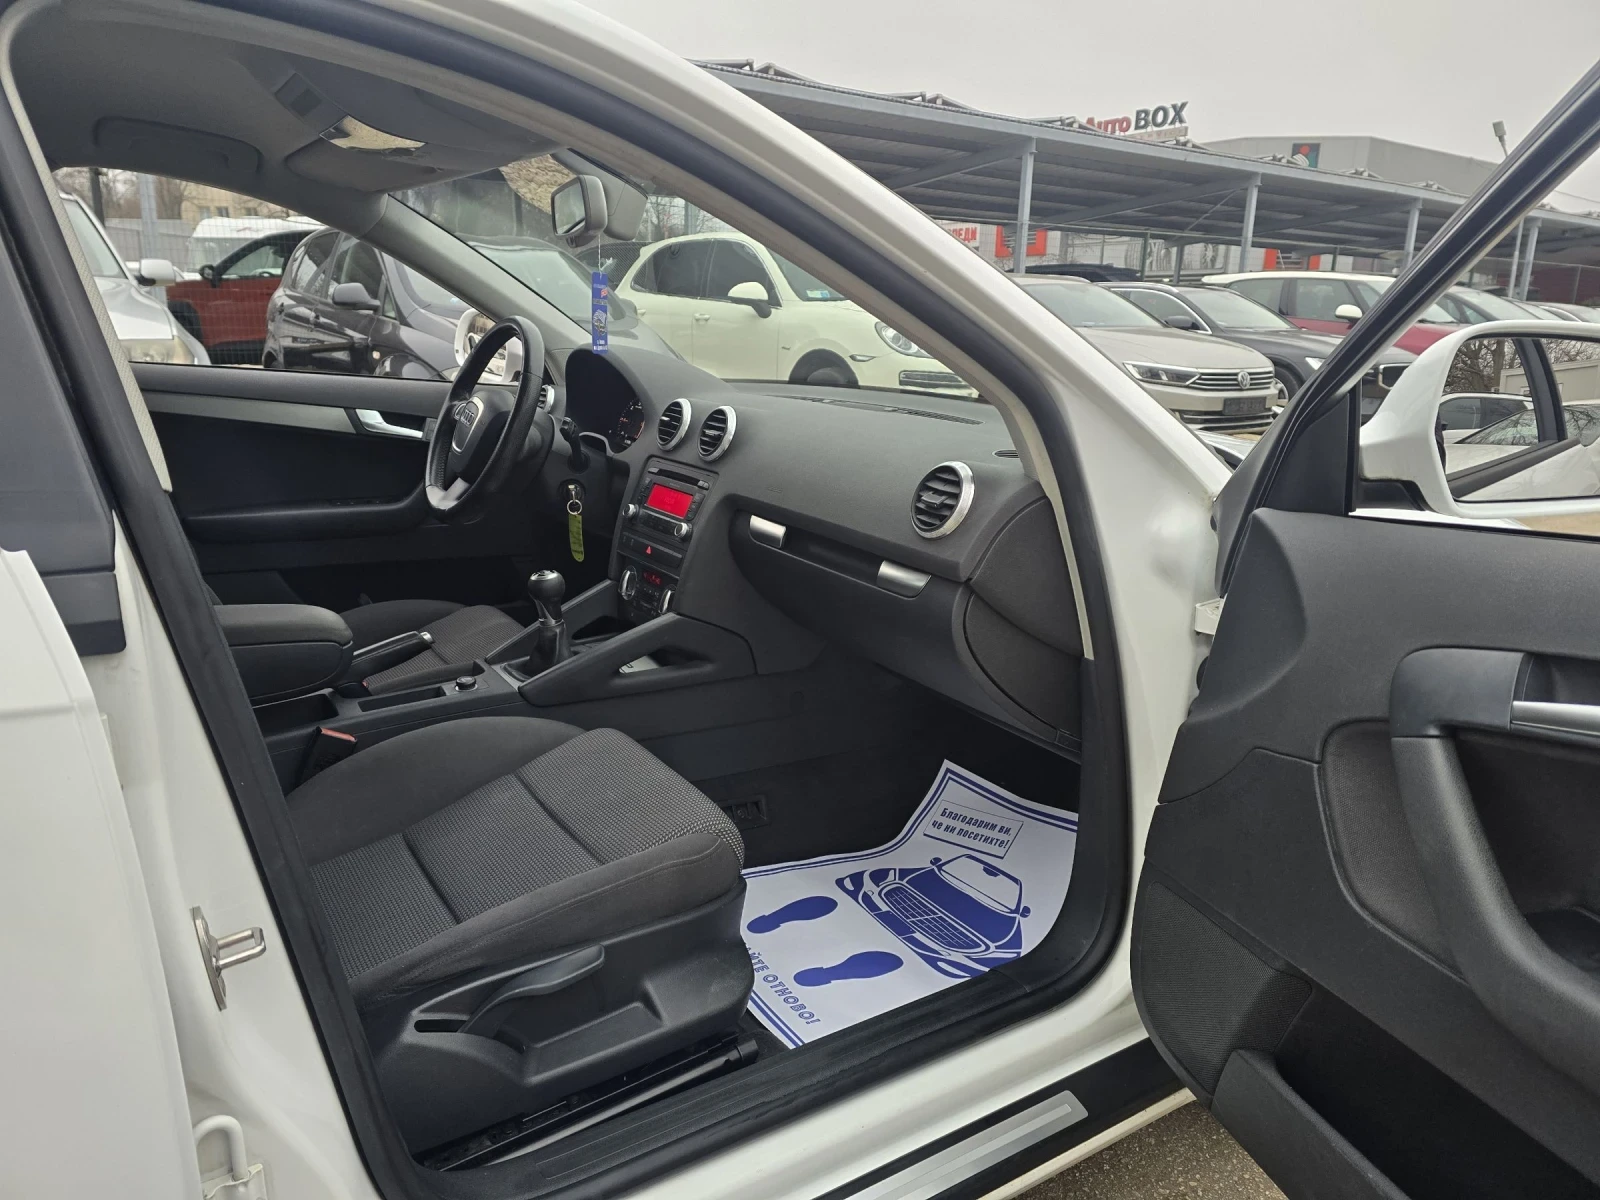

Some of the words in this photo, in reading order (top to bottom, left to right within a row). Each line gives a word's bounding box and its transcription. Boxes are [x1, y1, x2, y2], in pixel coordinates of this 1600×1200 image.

[1134, 101, 1188, 130] BOX
[940, 808, 997, 831] Благодарим
[932, 820, 943, 830] че
[943, 824, 957, 834] ни
[957, 829, 1010, 849] посетихте!
[747, 947, 770, 973] ЙТЕ
[763, 974, 821, 1024] ОТНОВО!
